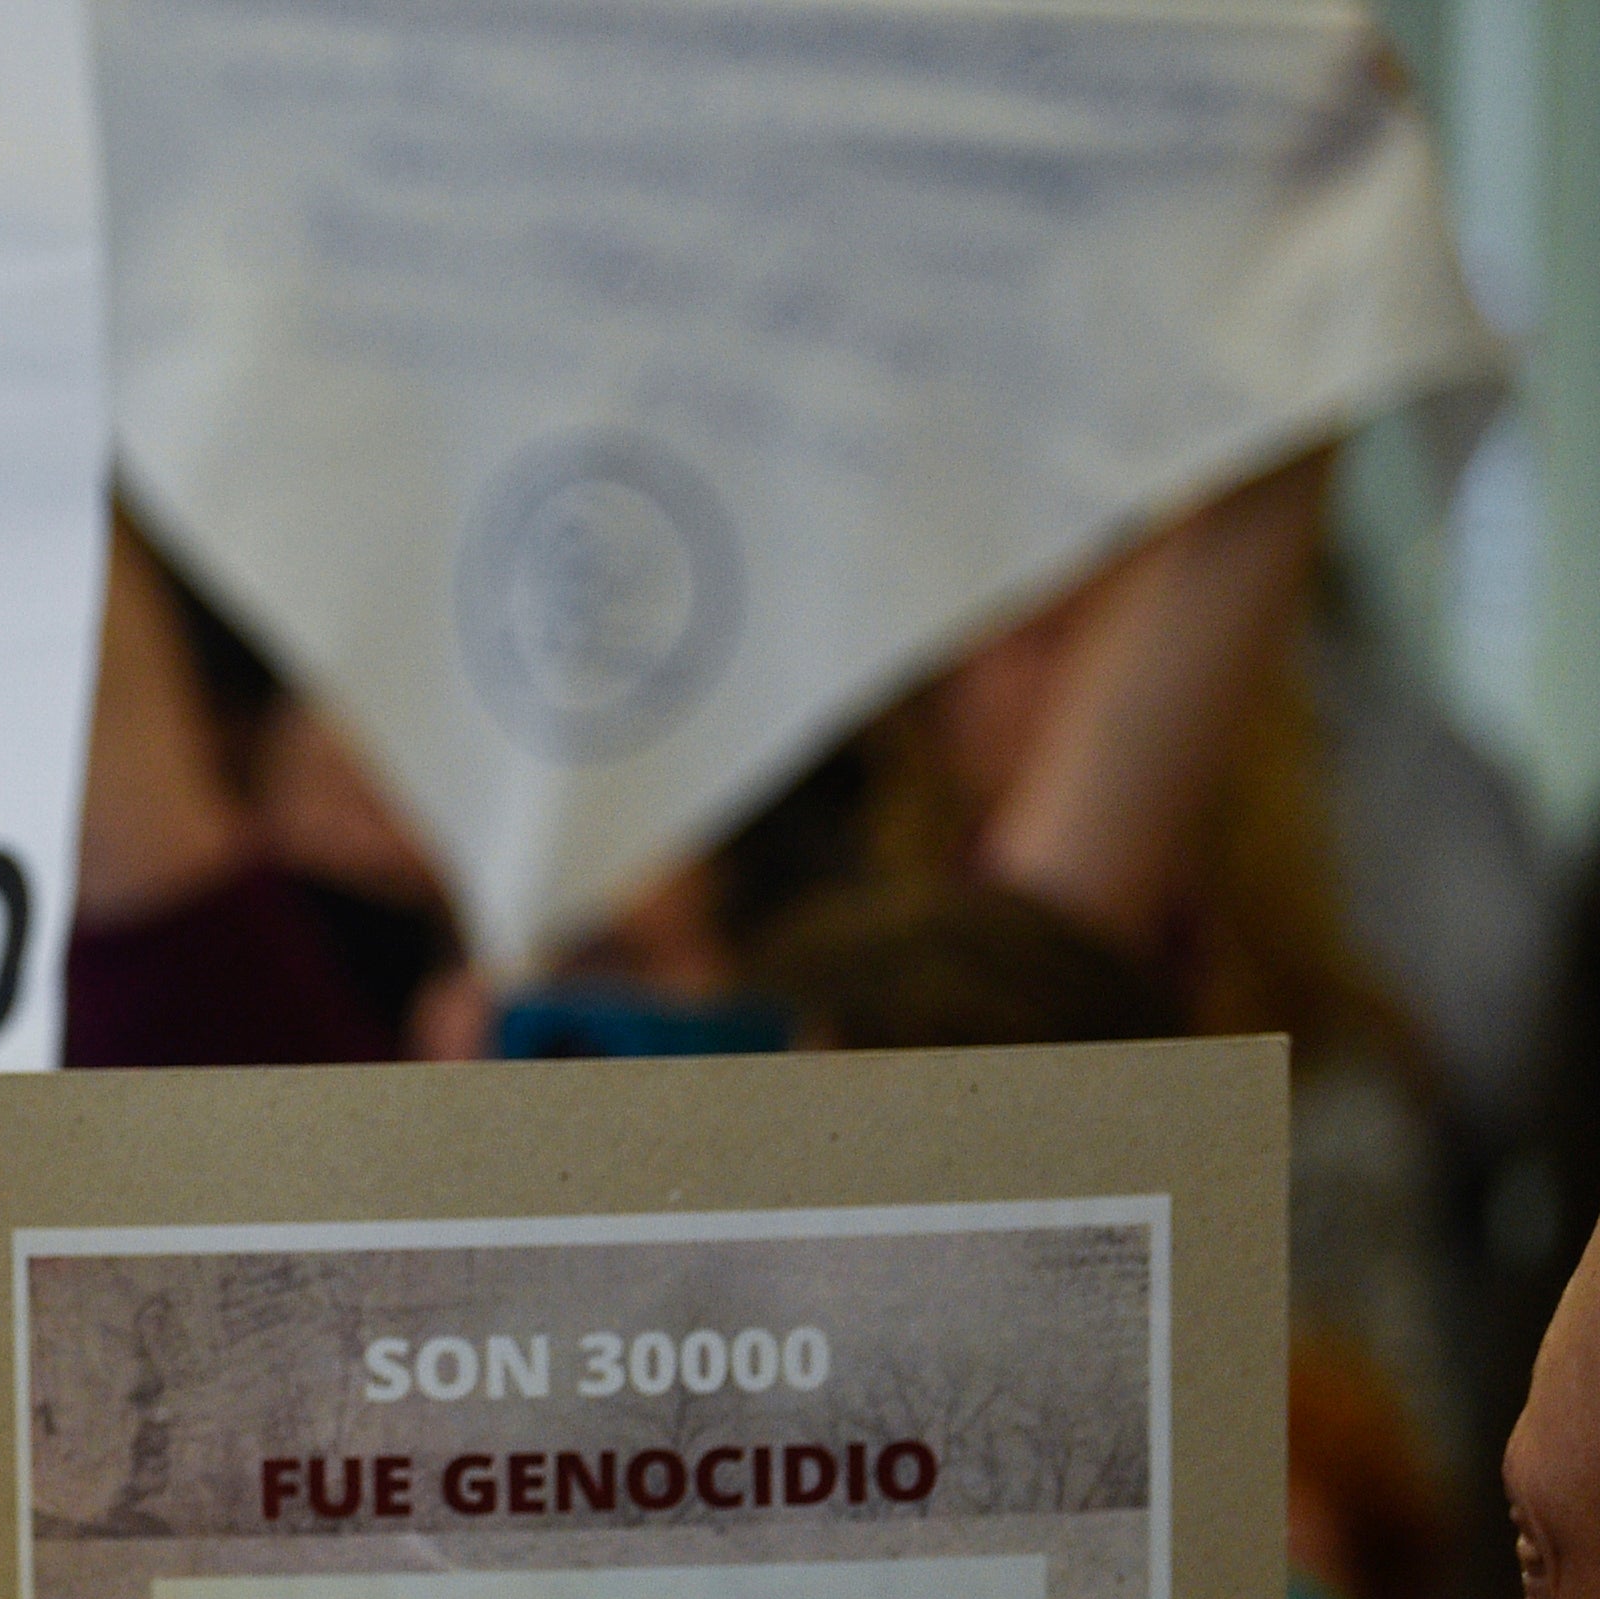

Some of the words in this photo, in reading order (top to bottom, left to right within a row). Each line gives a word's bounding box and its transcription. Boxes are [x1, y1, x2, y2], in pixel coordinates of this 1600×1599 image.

[362, 1334, 552, 1402] SON
[576, 1326, 833, 1400] 30000
[259, 1453, 414, 1521] FUE
[441, 1439, 940, 1516] GENOCIDIO
